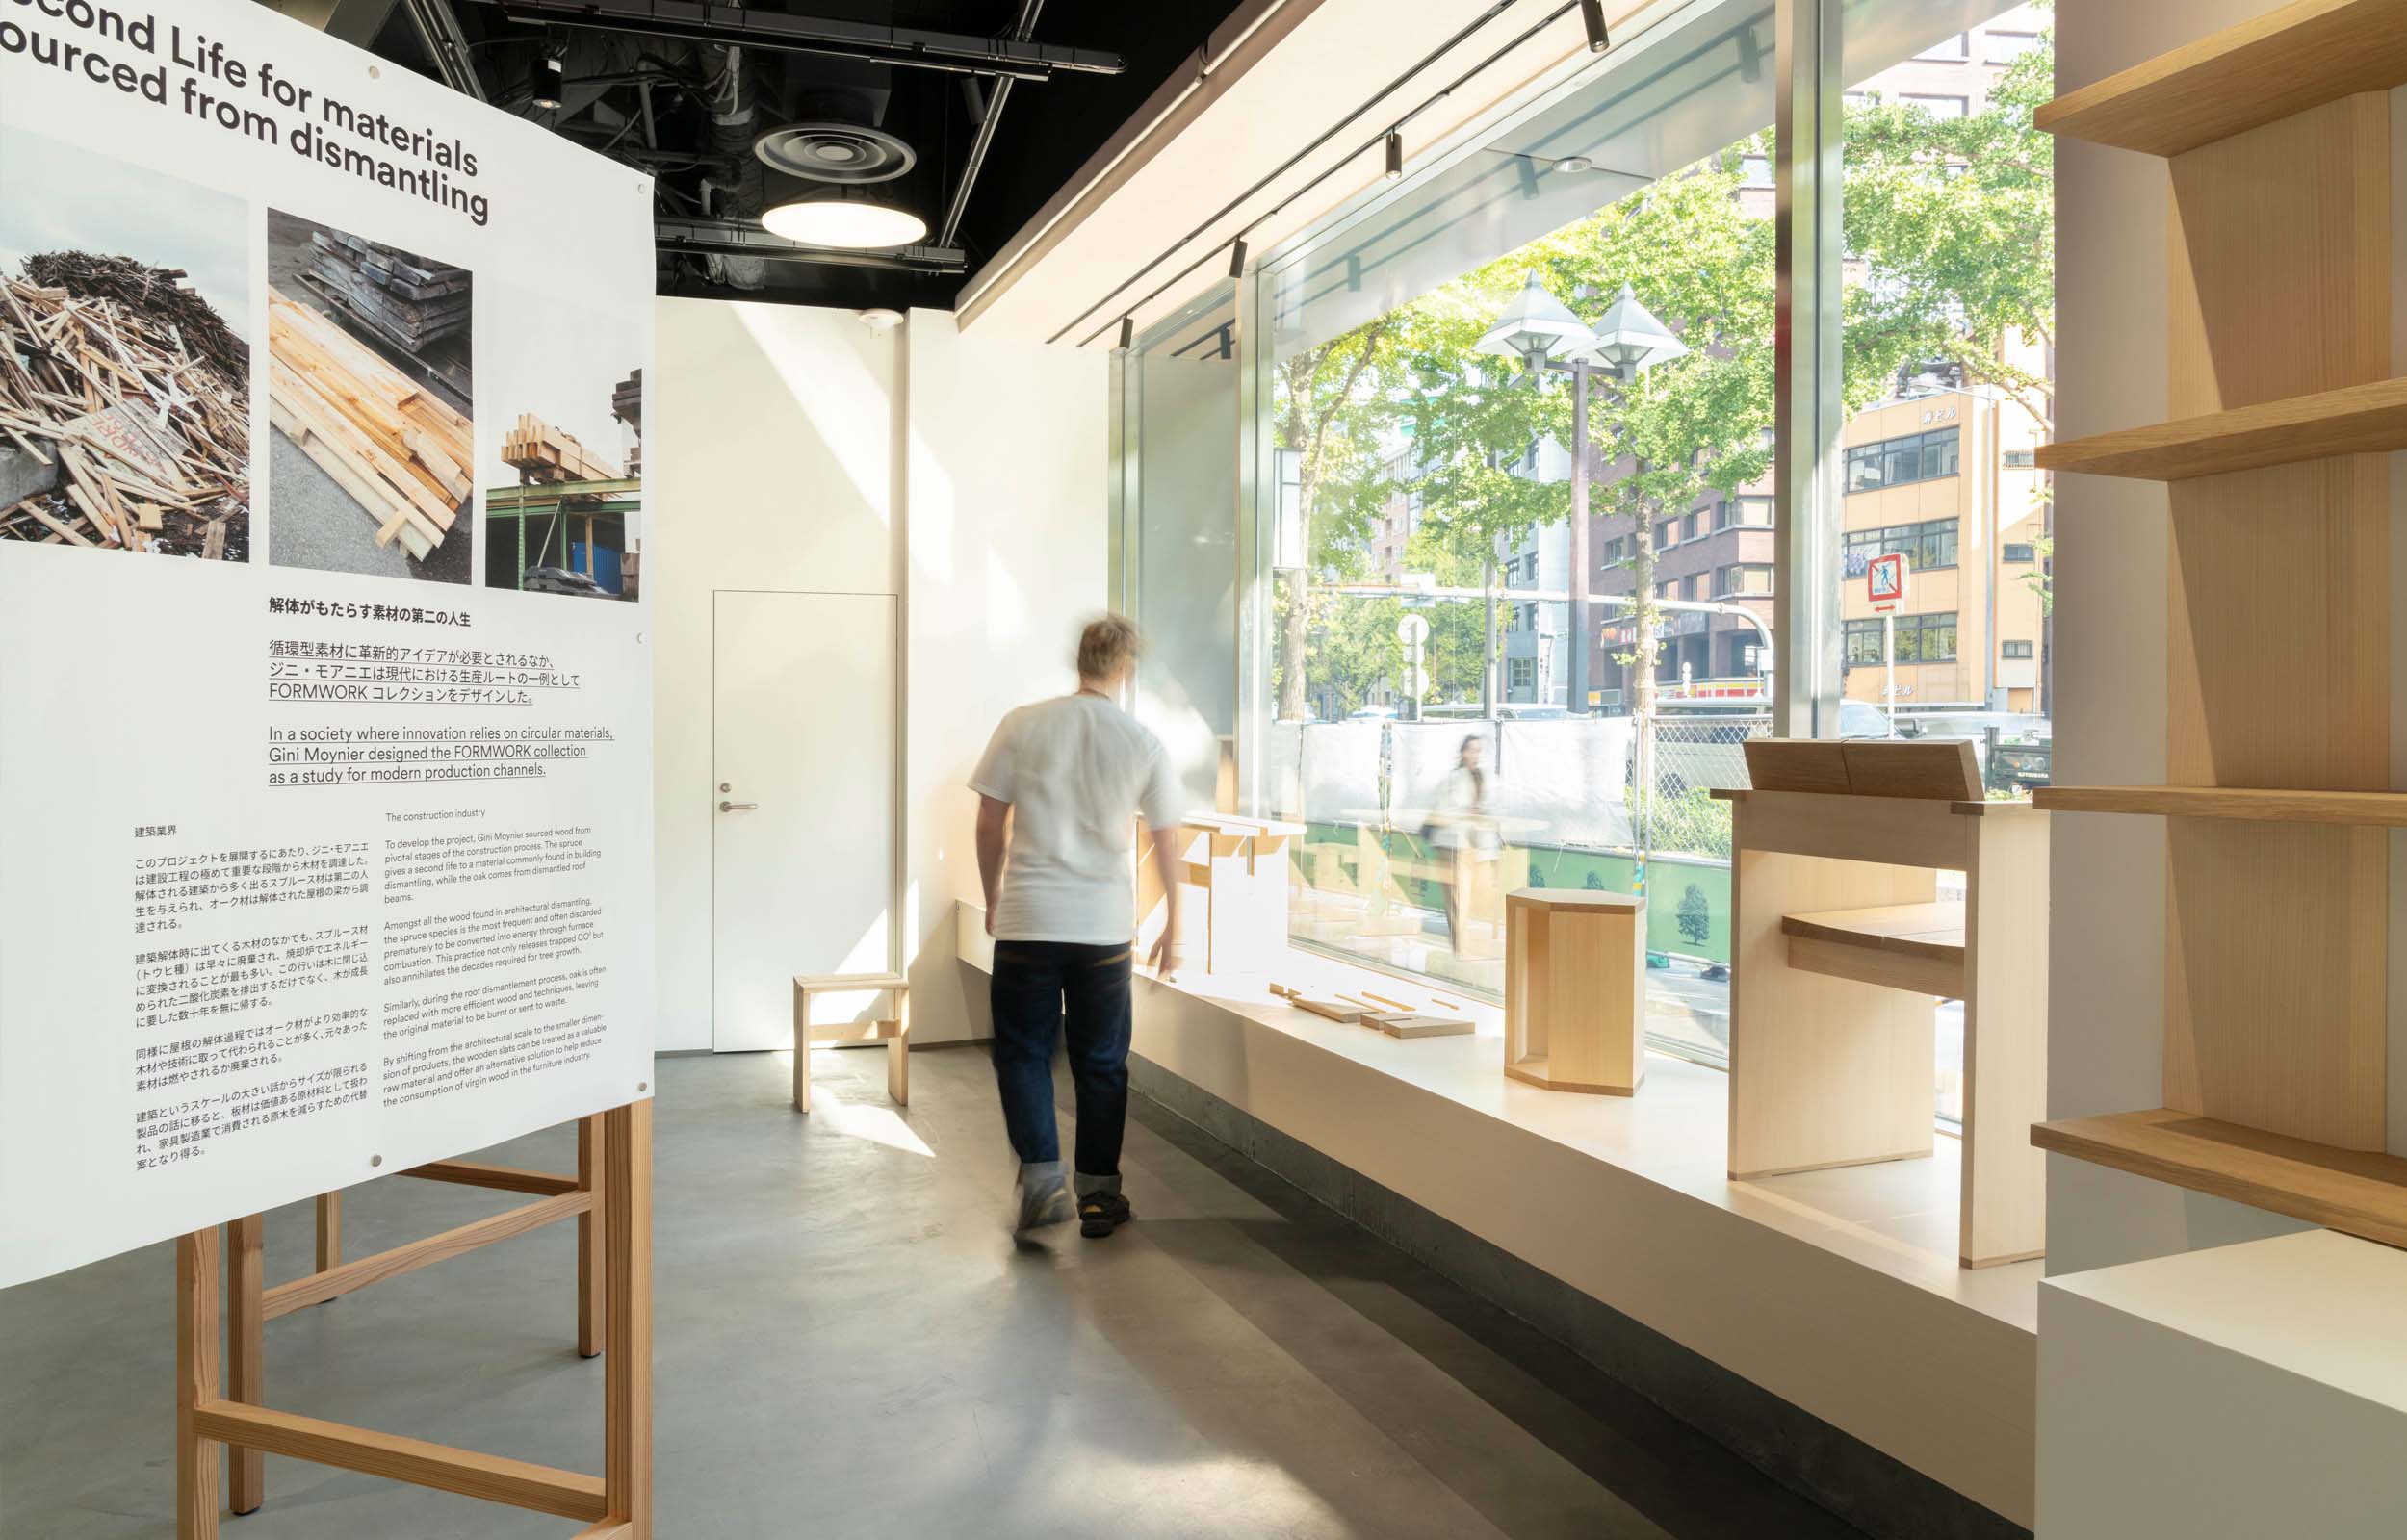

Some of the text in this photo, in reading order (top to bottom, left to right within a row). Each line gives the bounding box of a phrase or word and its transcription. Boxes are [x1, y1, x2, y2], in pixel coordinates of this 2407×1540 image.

[13, 0, 477, 180] cond Life for materials
[181, 78, 277, 144] from
[291, 122, 487, 226] dismantling
[270, 683, 368, 700] FORMWORK
[270, 726, 613, 742] In a society where innovation relies on circular materials,
[269, 744, 585, 762] Gini Moynier designed the FORMWORK collection
[269, 762, 546, 783] as a study for modern production channels.
[403, 808, 485, 821] construction industry
[135, 825, 176, 837] 建築業界
[397, 838, 429, 849] develop
[446, 835, 476, 846] project,
[477, 833, 493, 842] Gini
[494, 832, 524, 841] Moynier
[384, 868, 406, 879] gives
[414, 862, 444, 874] second
[445, 861, 458, 870] life
[475, 857, 505, 868] material
[385, 852, 412, 864] pivotal
[414, 852, 441, 861] stages
[466, 846, 512, 857] construction
[436, 874, 457, 885] while
[487, 870, 512, 880] comes
[513, 867, 531, 877] from
[384, 894, 414, 904] beams.
[135, 918, 182, 934] 達される。
[383, 918, 421, 931] Amongst
[449, 911, 471, 922] wood
[472, 909, 494, 919] found
[400, 933, 427, 944] spruce
[428, 928, 458, 939] species
[481, 921, 501, 931] most
[502, 916, 533, 929] frequent
[383, 957, 434, 972] combustion.
[435, 953, 453, 962] This
[453, 948, 485, 962] practice
[501, 943, 517, 954] only
[384, 942, 433, 960] prematurely
[456, 934, 496, 947] converted
[497, 933, 511, 941] into
[512, 930, 538, 939] energy
[383, 976, 401, 986] also
[401, 968, 445, 983] annihilates
[461, 961, 494, 972] decades
[495, 954, 526, 966] required
[383, 998, 421, 1013] Similarly,
[422, 994, 449, 1006] during
[464, 987, 480, 997] roof
[481, 978, 537, 994] dismantlement
[383, 1011, 420, 1026] replaced
[421, 1008, 439, 1018] with
[441, 1005, 462, 1015] more
[463, 998, 495, 1011] efficient
[496, 993, 517, 1005] wood
[399, 1022, 429, 1037] original
[431, 1015, 464, 1030] material
[487, 1008, 507, 1019] burnt
[518, 1003, 534, 1014] sent
[396, 1051, 427, 1065] shifting
[428, 1046, 449, 1057] from
[464, 1032, 513, 1049] architectural
[514, 1028, 533, 1039] scale
[383, 1070, 401, 1080] sion
[412, 1060, 451, 1076] products,
[467, 1049, 498, 1062] wooden
[499, 1045, 516, 1055] slats
[401, 1073, 435, 1090] material
[453, 1066, 474, 1078] offer
[485, 1055, 526, 1070] alternative
[399, 1085, 453, 1103] consumption
[465, 1076, 487, 1088] virgin
[488, 1069, 509, 1083] wood
[137, 1145, 205, 1171] 案となり得る。
